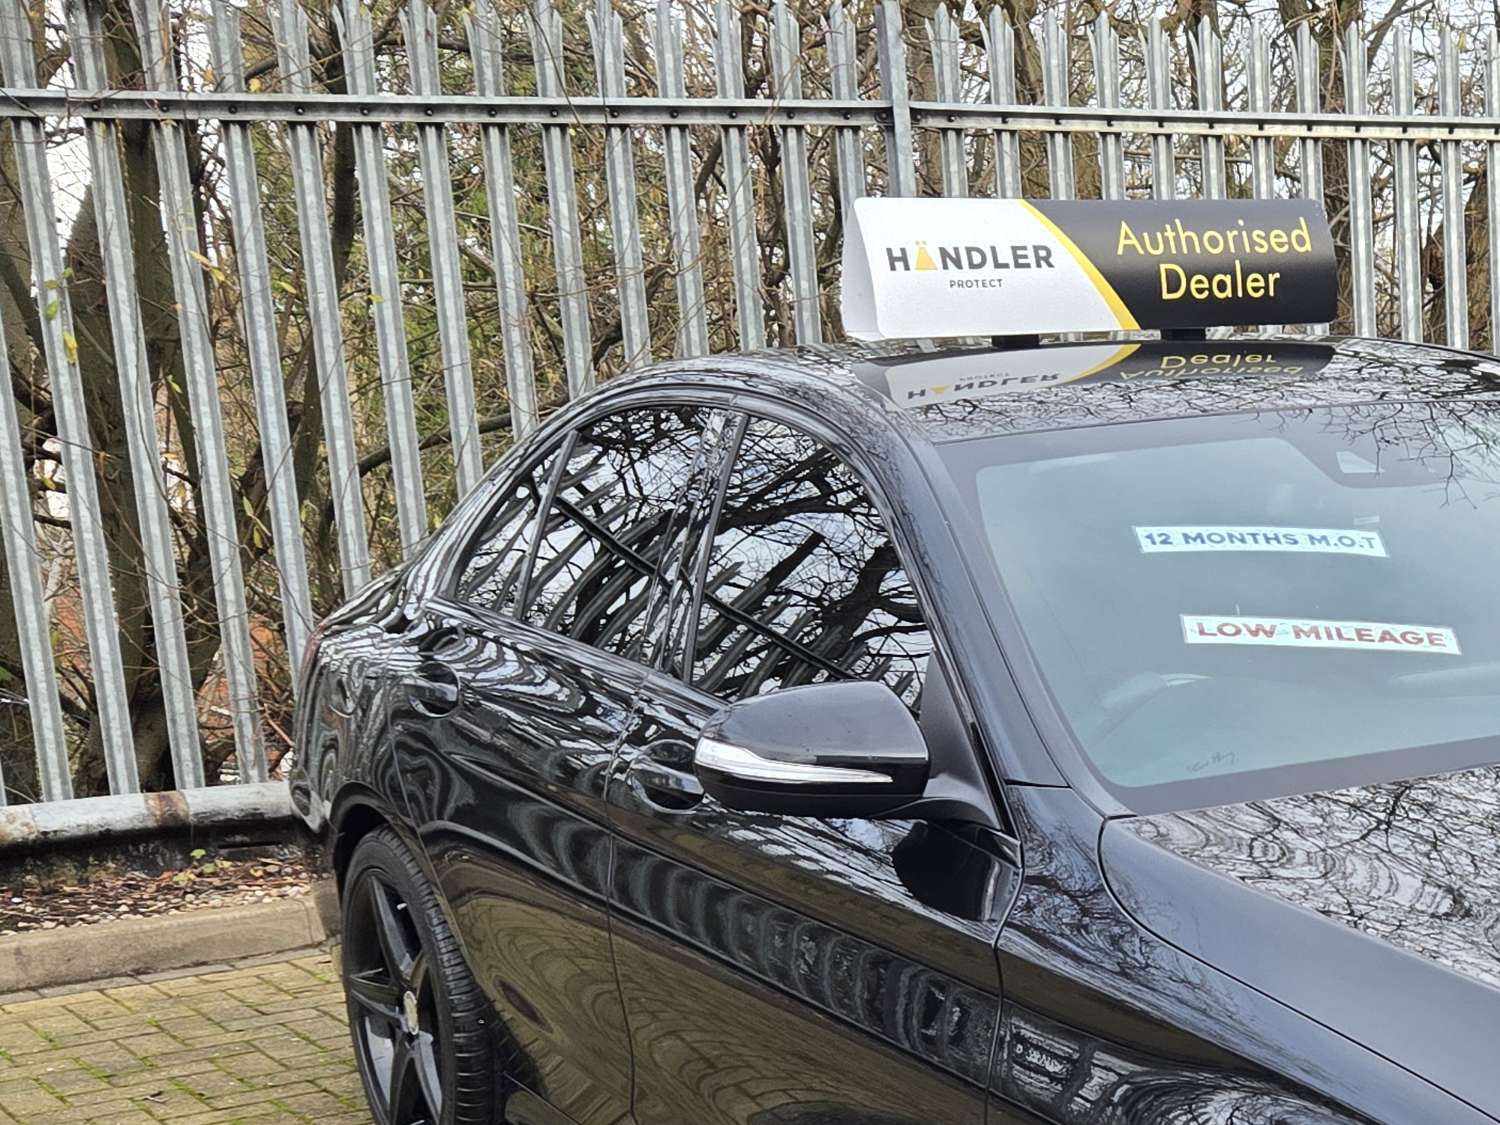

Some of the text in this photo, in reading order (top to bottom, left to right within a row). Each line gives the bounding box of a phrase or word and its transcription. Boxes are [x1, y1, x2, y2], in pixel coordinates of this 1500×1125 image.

[1116, 216, 1313, 256] Authorised
[886, 240, 1055, 271] HÄNDLER
[949, 278, 1004, 289] PROTECT
[1159, 263, 1281, 300] Dealer
[1144, 532, 1376, 549] 12 MONTHS M.O.T
[1197, 622, 1447, 647] LOW MILEAGE
